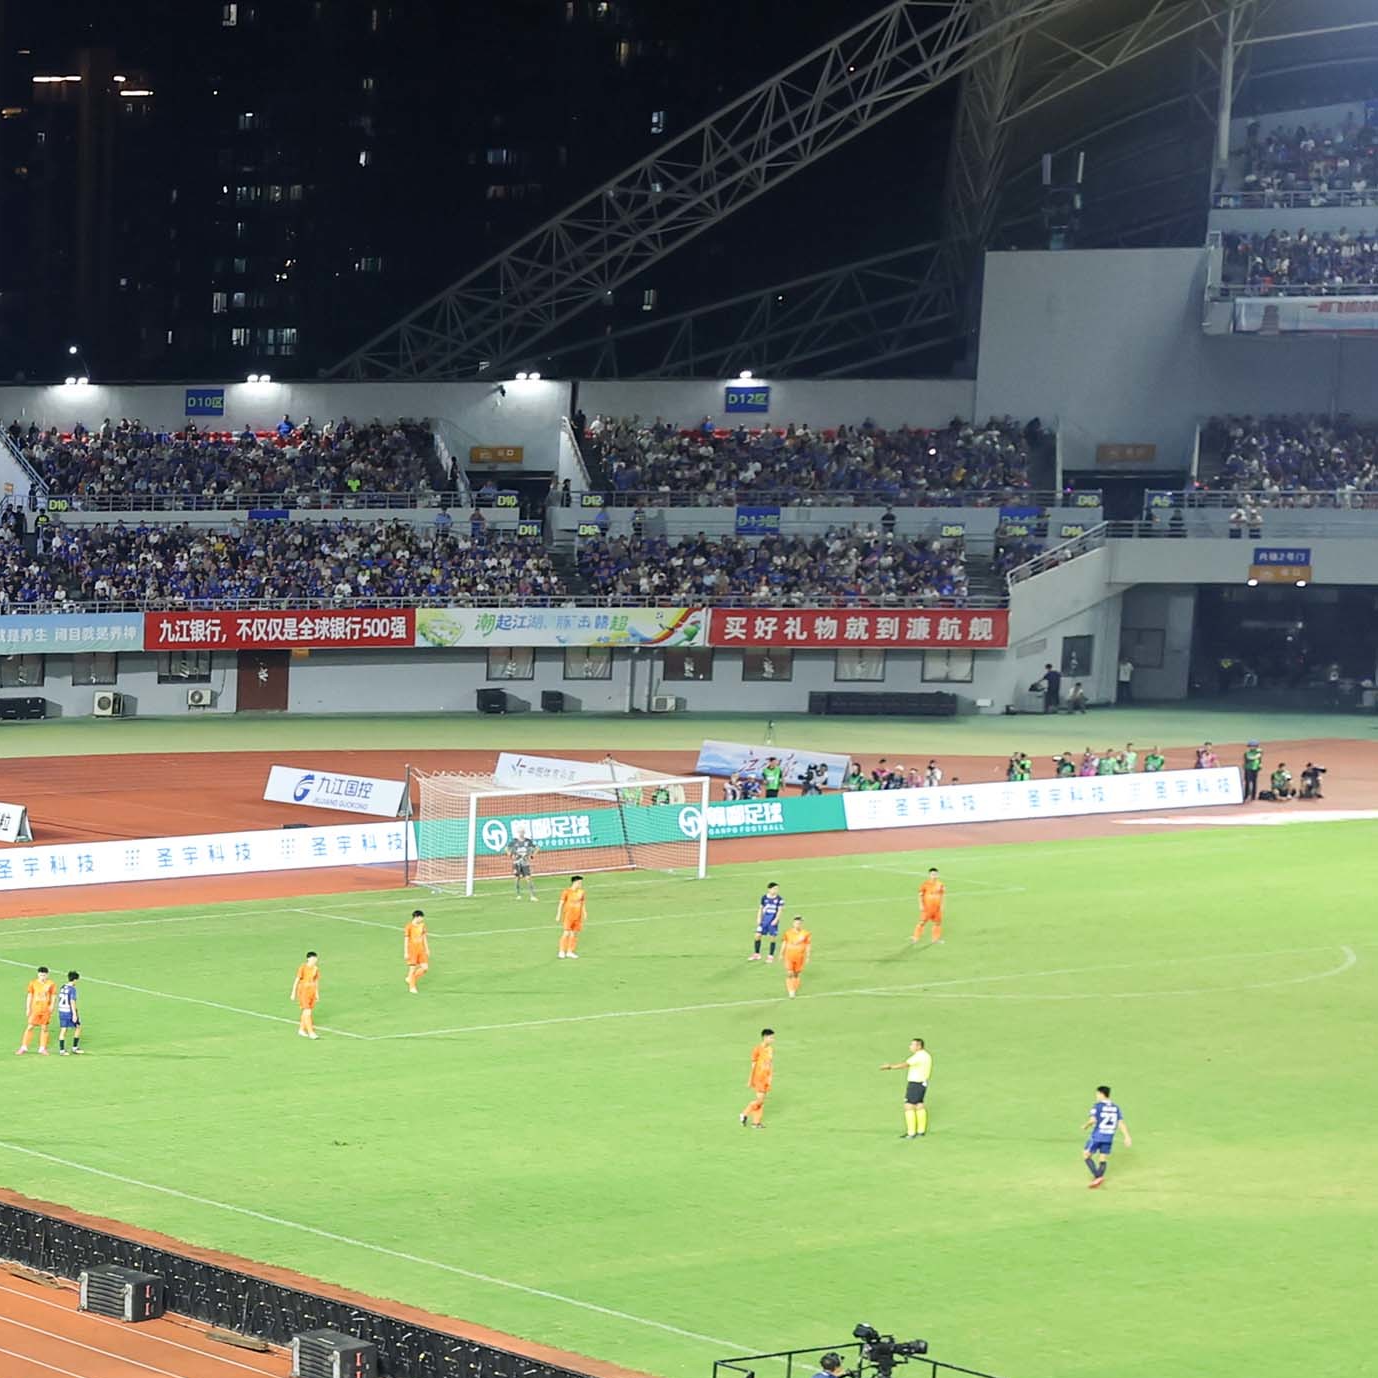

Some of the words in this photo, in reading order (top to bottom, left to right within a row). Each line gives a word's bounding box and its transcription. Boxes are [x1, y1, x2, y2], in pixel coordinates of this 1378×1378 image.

[188, 397, 223, 408] D10区
[728, 394, 766, 405] D12区
[49, 500, 67, 510] D10
[159, 616, 407, 643] 九江银行，不仅仅是全球银行500强
[317, 776, 374, 799] 九江国控
[311, 832, 403, 857] 圣宇科技
[156, 842, 252, 868] 圣宇科技
[1099, 1111, 1118, 1128] 23
